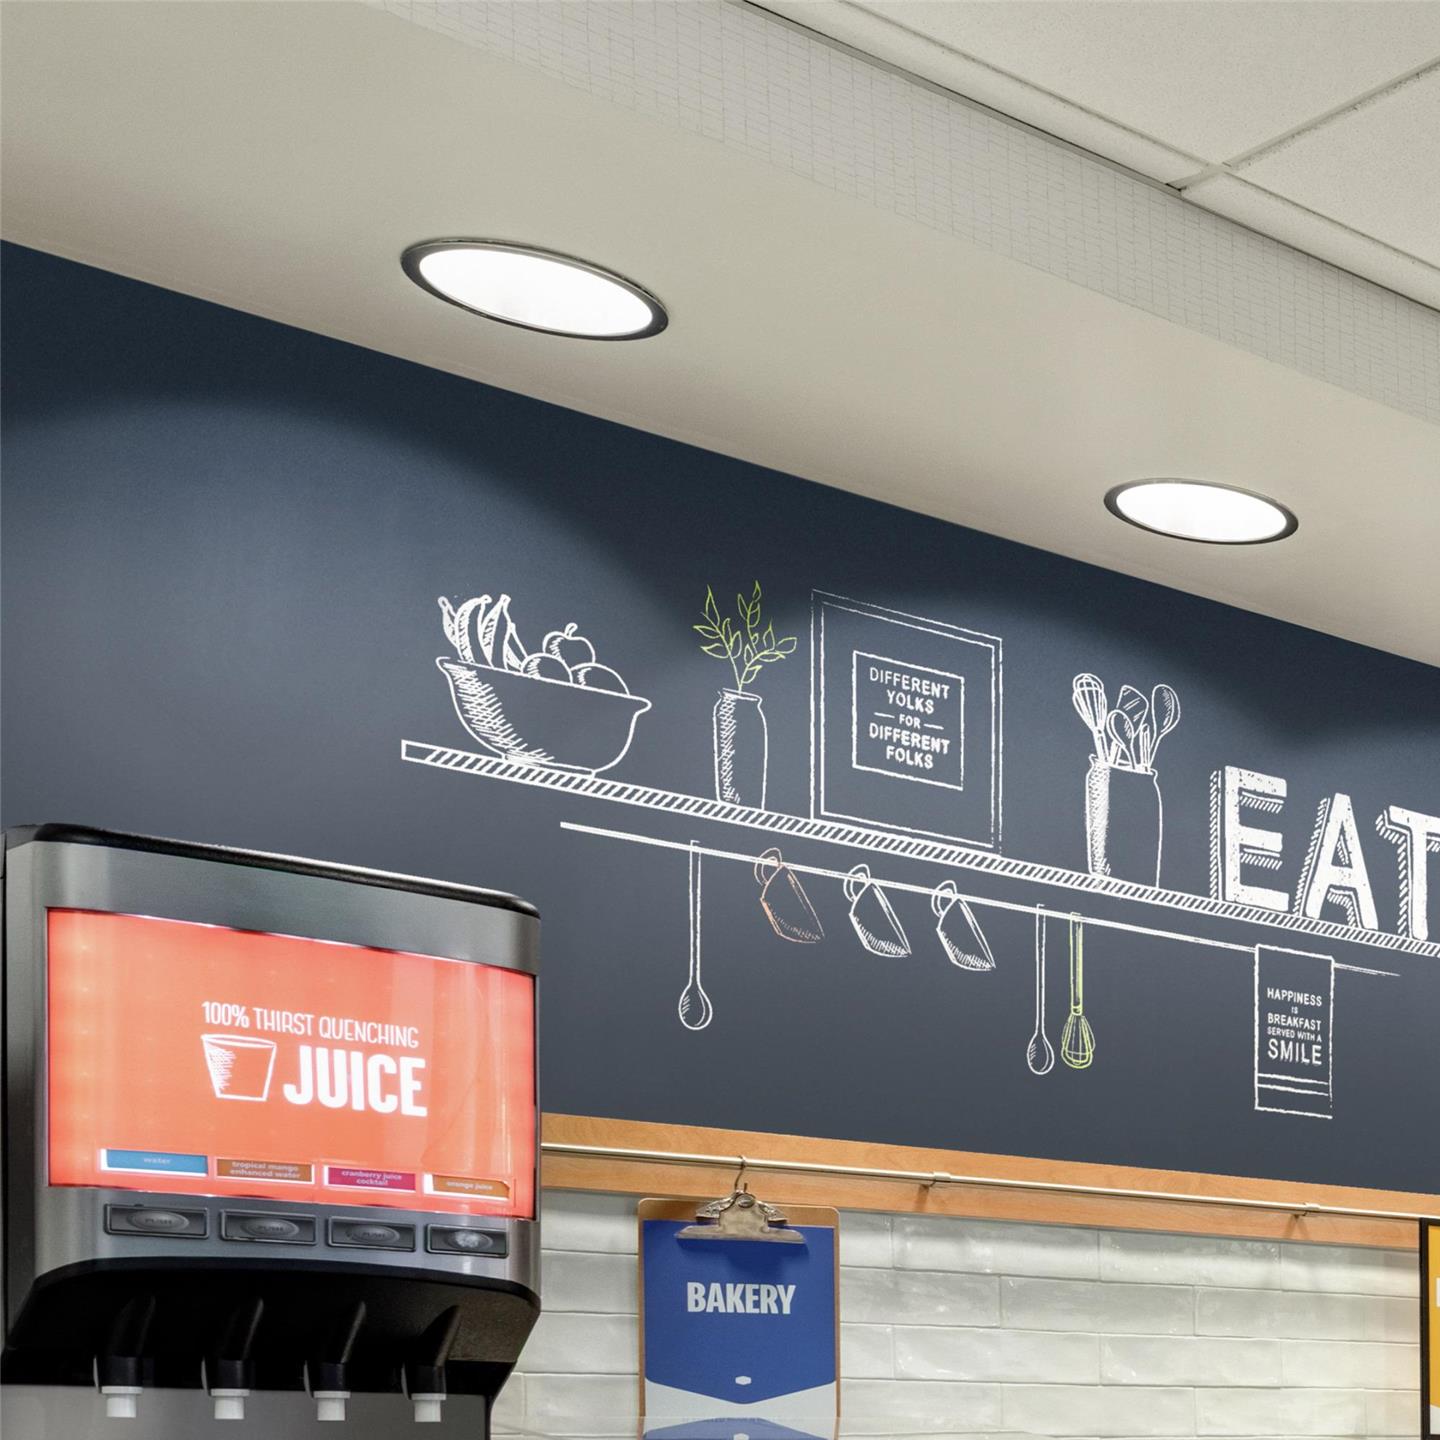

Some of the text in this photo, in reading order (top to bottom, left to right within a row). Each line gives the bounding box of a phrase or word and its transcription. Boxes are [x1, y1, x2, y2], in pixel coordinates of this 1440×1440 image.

[869, 667, 950, 700] DIFFERENT
[886, 689, 934, 715] YOLKS
[899, 713, 921, 729] FOR
[869, 722, 950, 755] DIFFERENT
[886, 745, 934, 770] FOLKS
[1267, 987, 1322, 1007] HAPPINESS
[1291, 1006, 1299, 1014] IS
[201, 1001, 419, 1048] 100% THIRST QUENCHING
[1267, 1012, 1322, 1031] BREAKFAST
[1267, 1026, 1322, 1042] SERVED WITH A
[1267, 1038, 1322, 1065] SMILE
[283, 1044, 428, 1117] JUICE
[230, 1168, 273, 1177] enhanced
[232, 1161, 266, 1170] tropical
[341, 1170, 402, 1181] cranberry juice
[356, 1178, 389, 1186] cocktail
[687, 1282, 796, 1315] BAKERY
